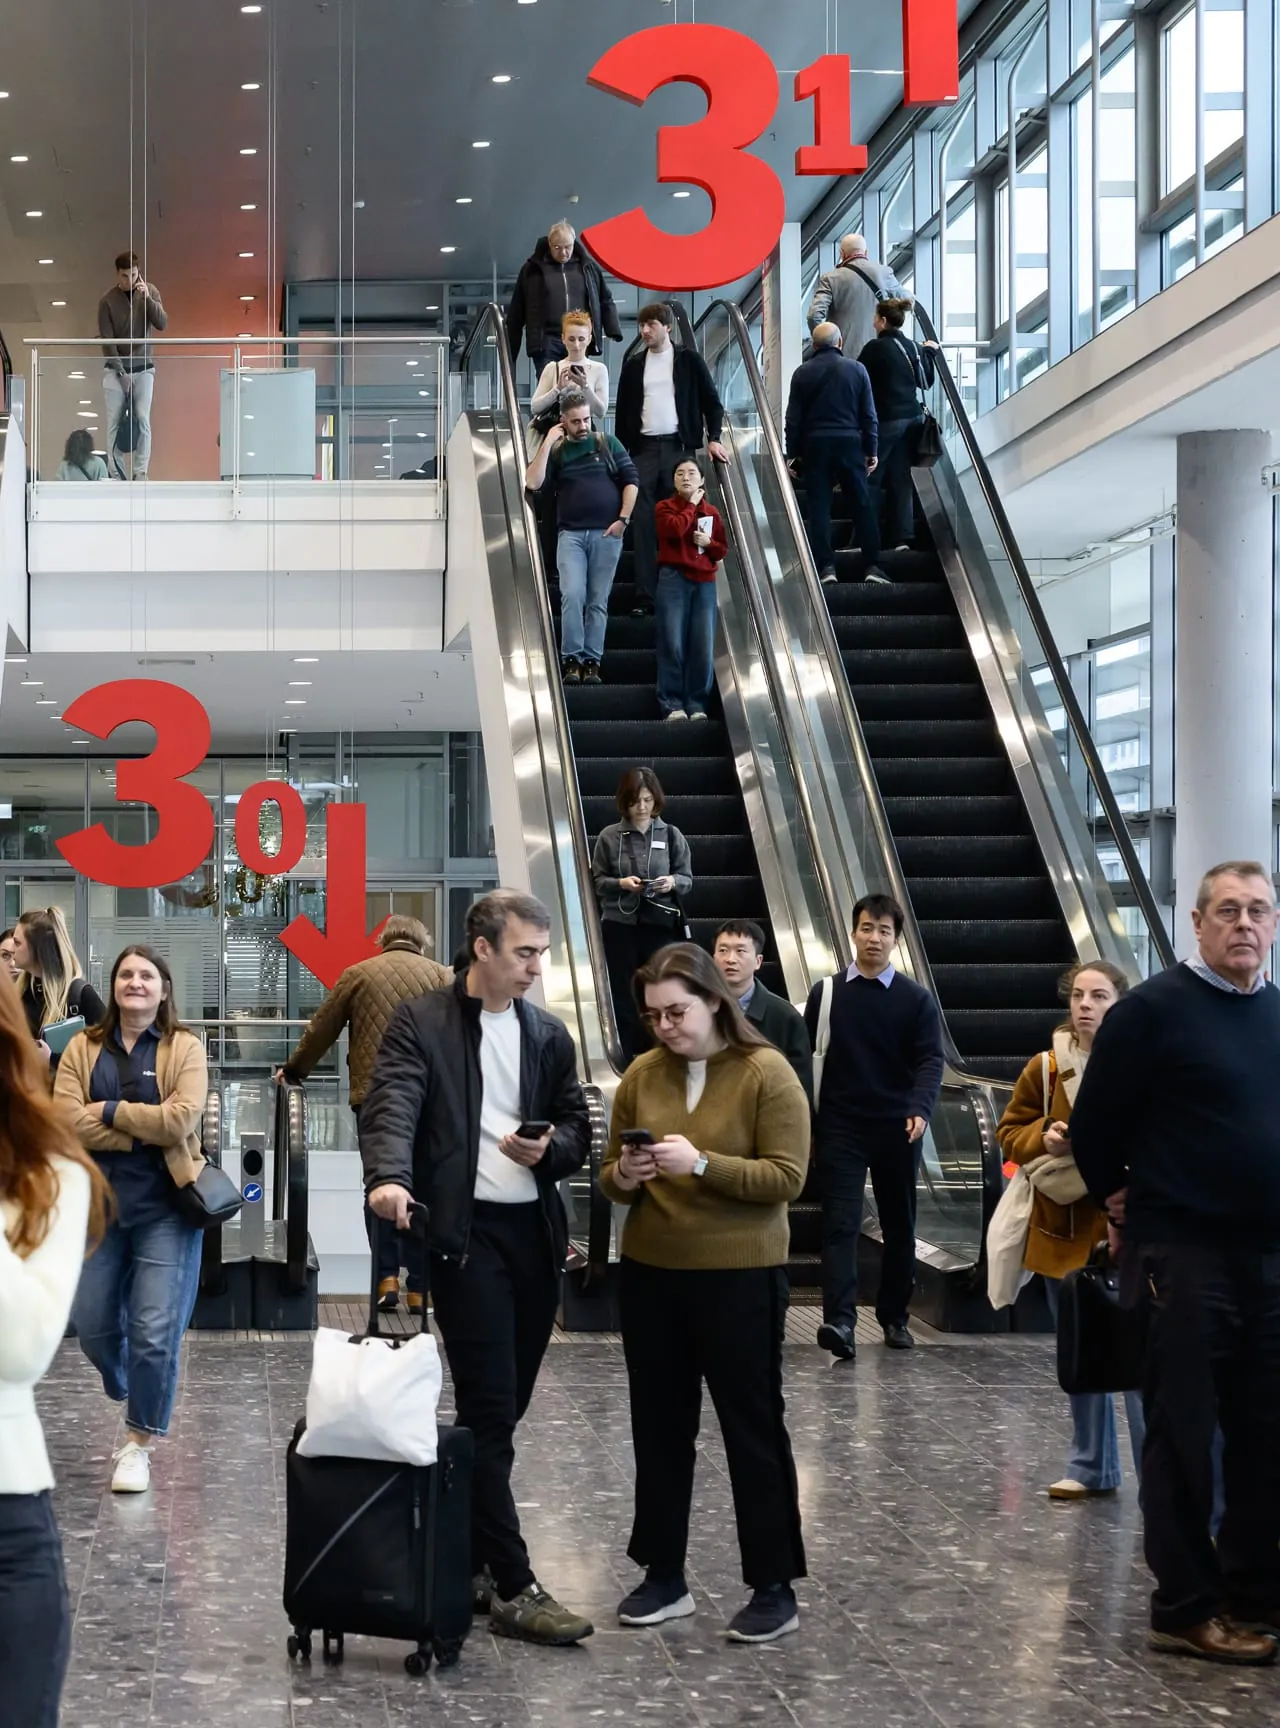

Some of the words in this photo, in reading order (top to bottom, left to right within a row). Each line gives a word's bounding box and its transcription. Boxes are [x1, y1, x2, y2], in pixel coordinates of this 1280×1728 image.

[581, 23, 785, 292] 3
[794, 54, 868, 176] 1
[55, 679, 215, 888] 3
